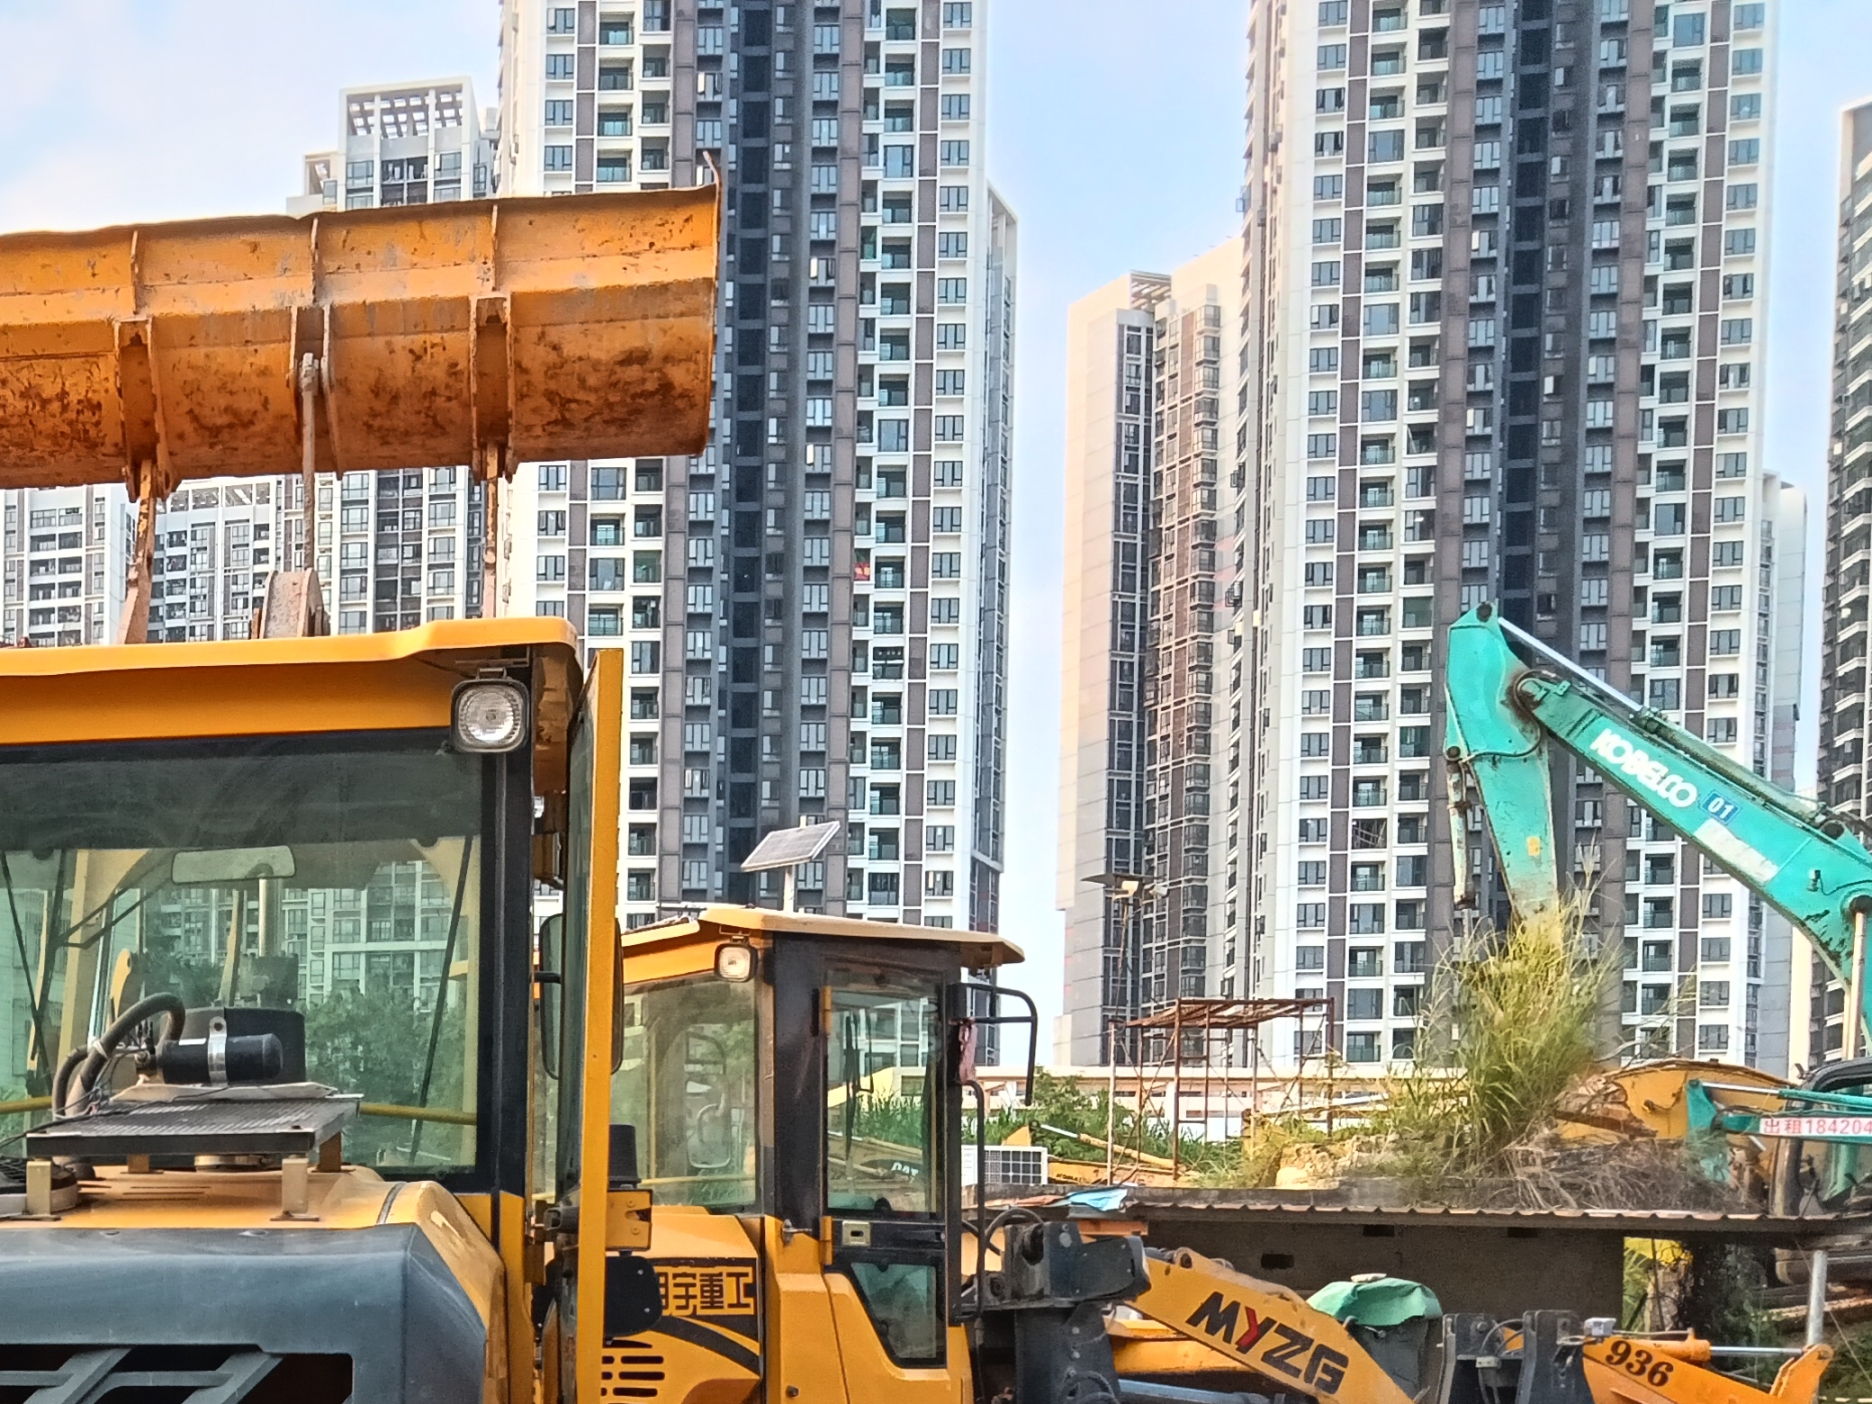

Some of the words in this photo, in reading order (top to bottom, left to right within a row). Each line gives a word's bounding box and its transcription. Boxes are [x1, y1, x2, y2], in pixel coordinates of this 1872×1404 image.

[1589, 728, 1698, 808] KOBELCO
[1708, 797, 1734, 820] 01
[1185, 1291, 1349, 1394] MYZG
[1605, 1340, 1674, 1387] 936
